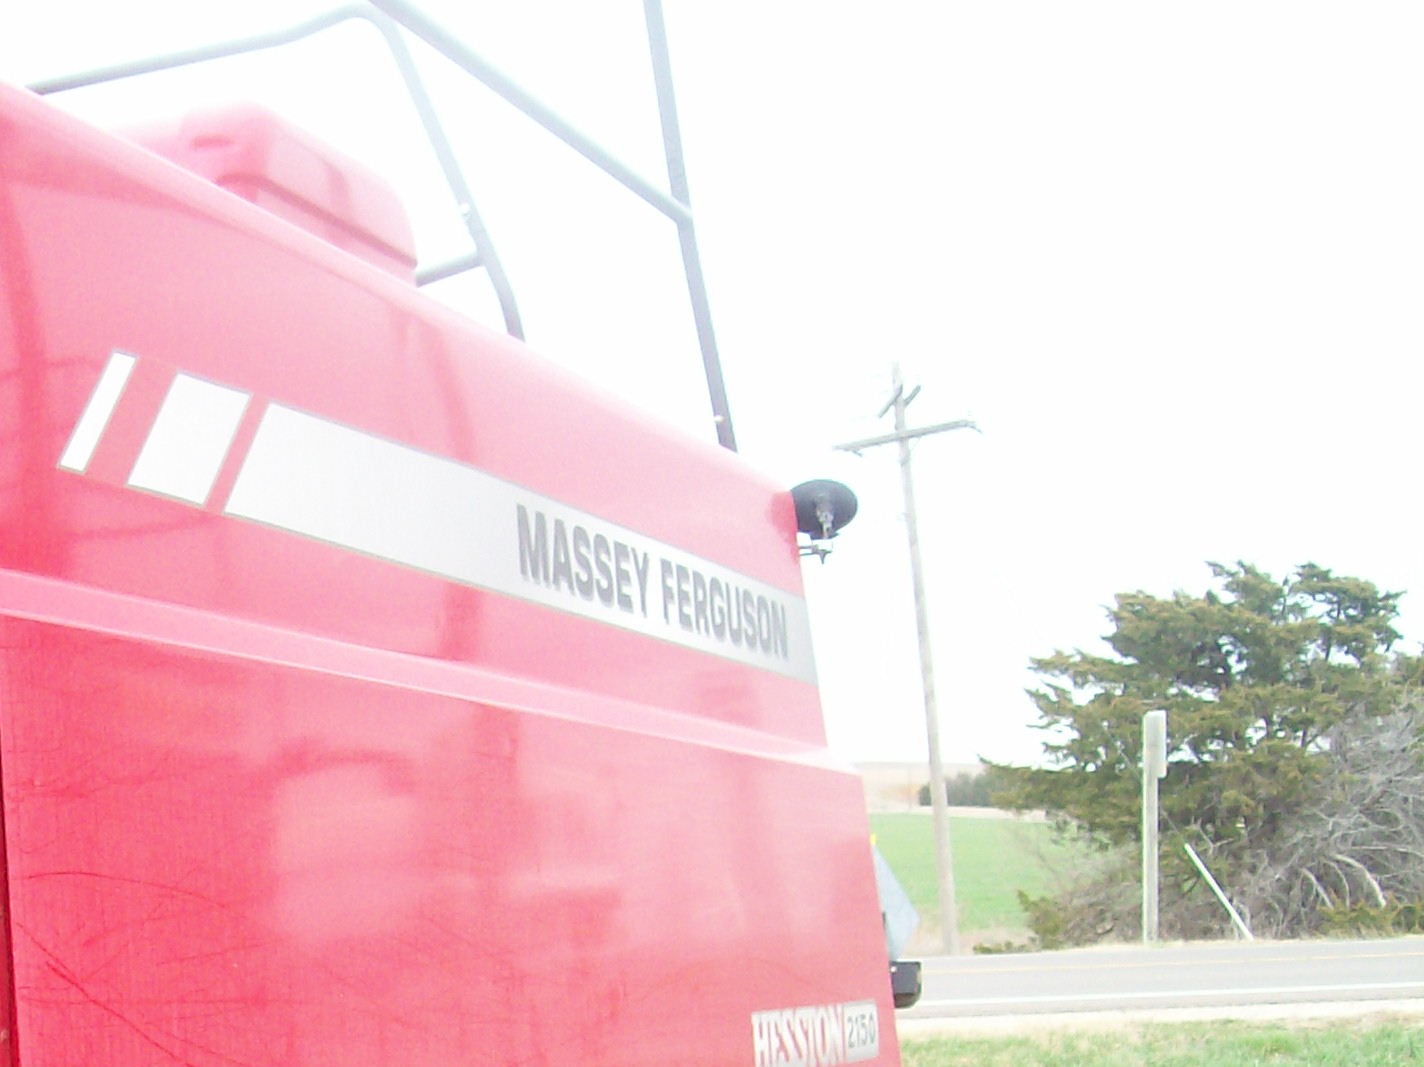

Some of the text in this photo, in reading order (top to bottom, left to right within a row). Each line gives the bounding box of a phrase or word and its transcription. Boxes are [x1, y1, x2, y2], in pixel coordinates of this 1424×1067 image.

[516, 504, 789, 659] MASSEY FERGUSON
[847, 1014, 876, 1049] 2150
